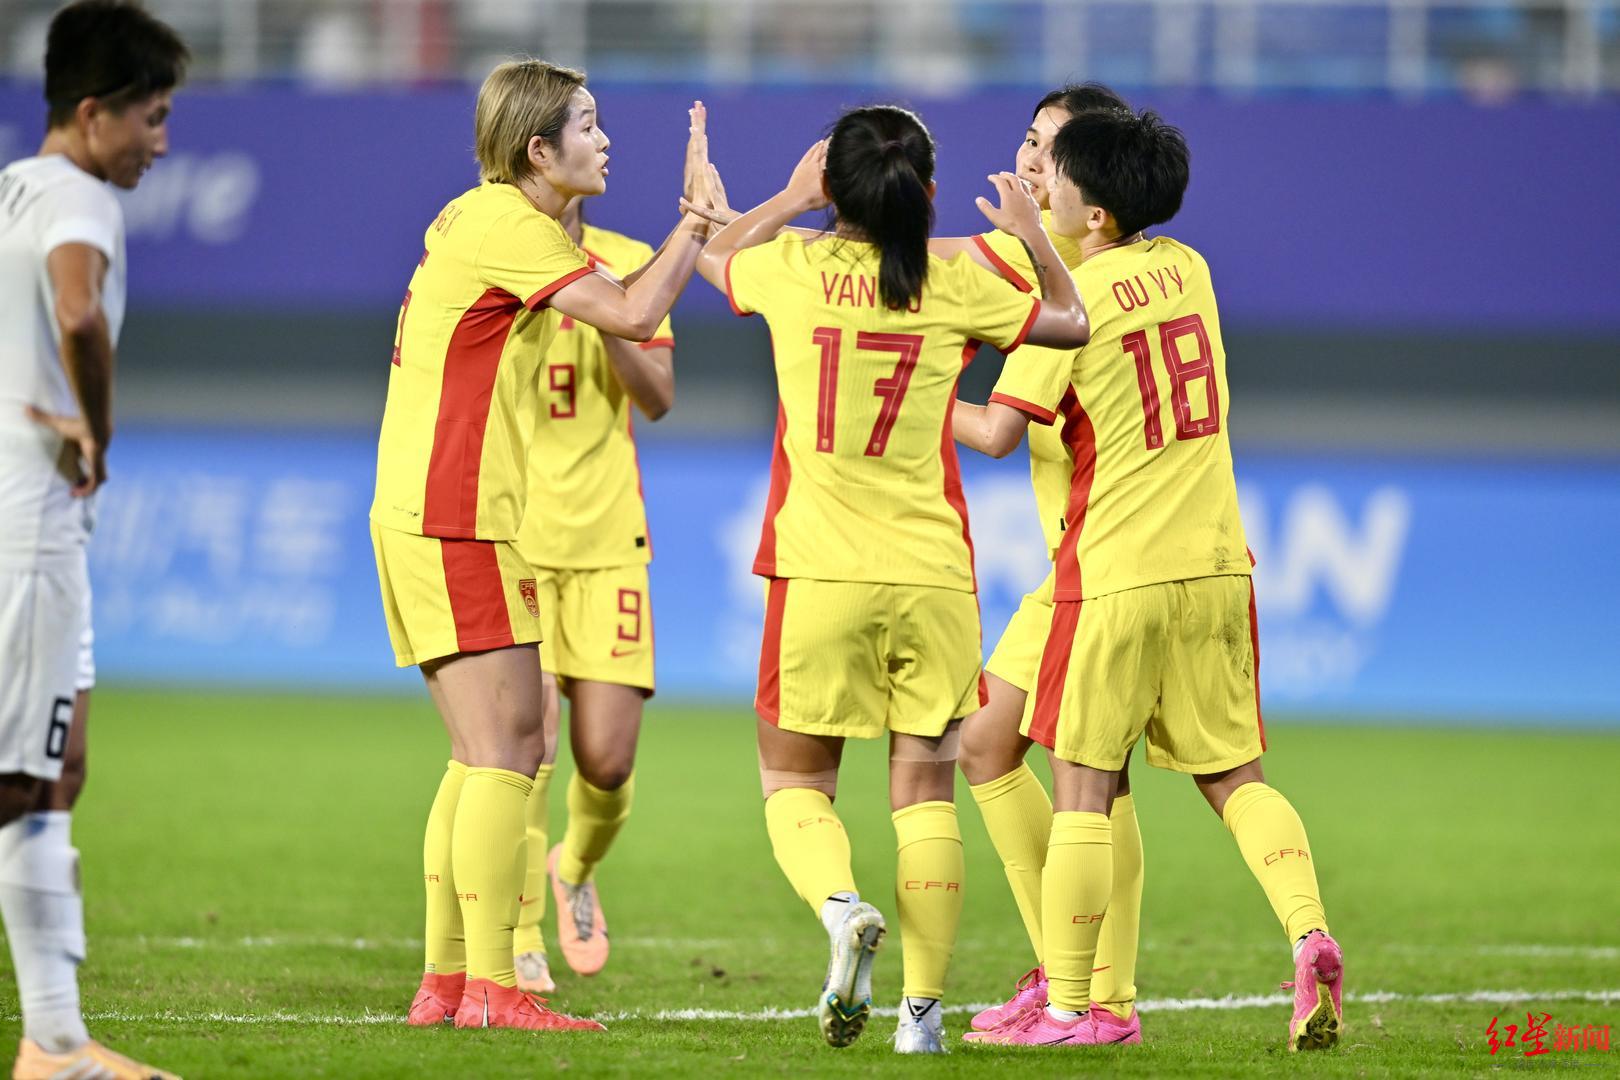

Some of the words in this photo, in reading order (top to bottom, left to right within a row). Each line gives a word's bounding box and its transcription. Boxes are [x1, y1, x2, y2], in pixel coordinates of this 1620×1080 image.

[820, 270, 877, 308] YAN
[1111, 275, 1150, 312] OU
[1146, 264, 1184, 300] YY
[548, 364, 576, 419] 9
[812, 326, 925, 457] 17
[1121, 313, 1220, 451] 18
[617, 587, 641, 643] 9
[45, 696, 73, 759] 6
[1263, 848, 1310, 866] CFA
[904, 880, 960, 893] CFA
